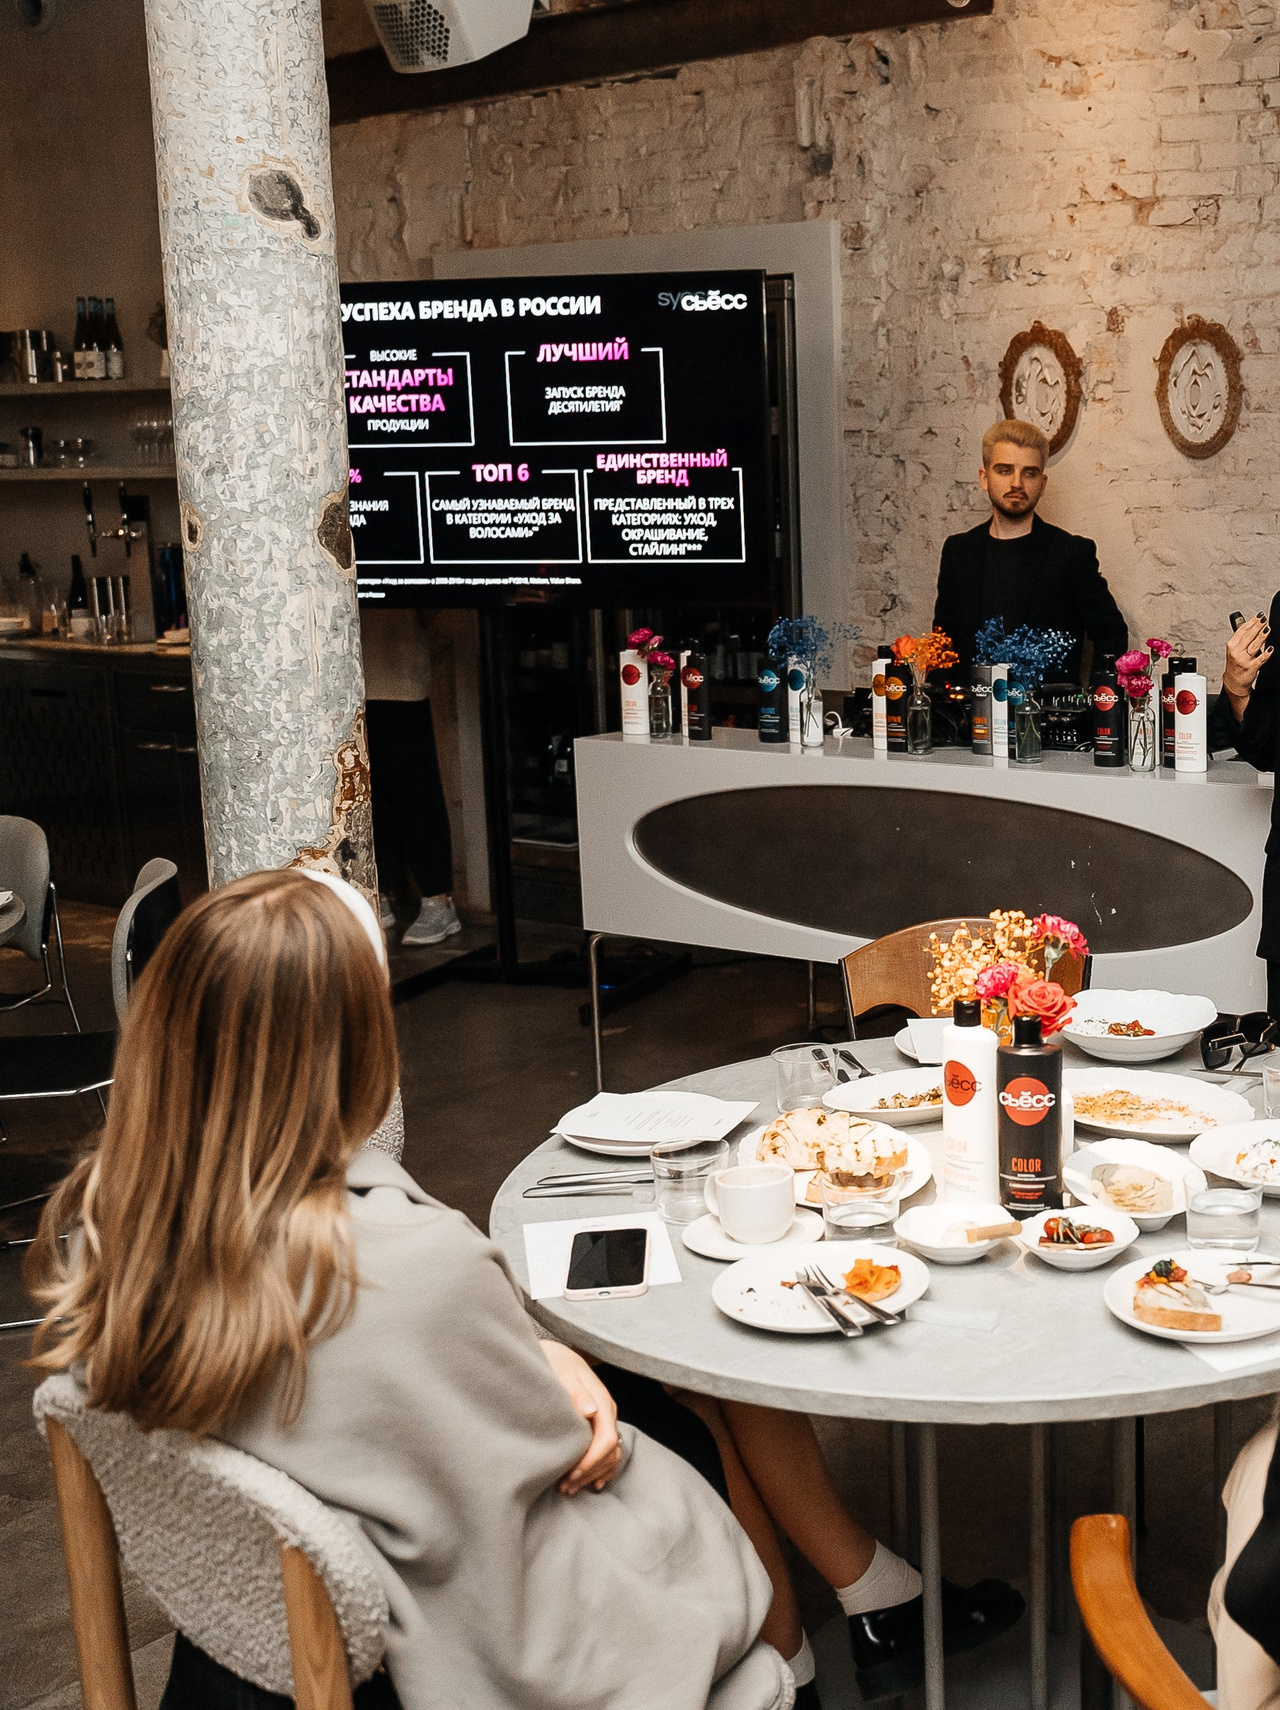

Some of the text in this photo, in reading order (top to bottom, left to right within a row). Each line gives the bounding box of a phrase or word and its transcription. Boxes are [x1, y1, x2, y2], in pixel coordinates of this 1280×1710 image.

[341, 295, 601, 322] УСПЕХА БРЕНДА В РОССИИ
[370, 349, 417, 362] ВЫСОКИЕ
[537, 337, 629, 362] ЛУЧШИЙ
[545, 386, 626, 399] ЗАПУСК БРЕНДА
[349, 394, 445, 413] КАЧЕСТВА
[367, 419, 429, 432] ПРОДУКЦИИ
[597, 449, 727, 472] ЕДИНСТВЕННЫЙ
[472, 463, 529, 482] ТОП 6
[637, 469, 689, 487] БРЕНД
[432, 496, 575, 512] САМЫЙ УЗНАВАЕМЫЙ БРЕНД
[594, 496, 734, 512] ПРЕДСТАВЛЕННЫЙ В ТРЕХ
[446, 512, 562, 527] В КАТЕГОРИИ «УХОД ЗА
[612, 514, 717, 528] КАТЕГОРИЯХ: УХОД,
[622, 528, 708, 542] ОКРАШИВАНИЕ,
[1012, 1157, 1042, 1172] COLOR
